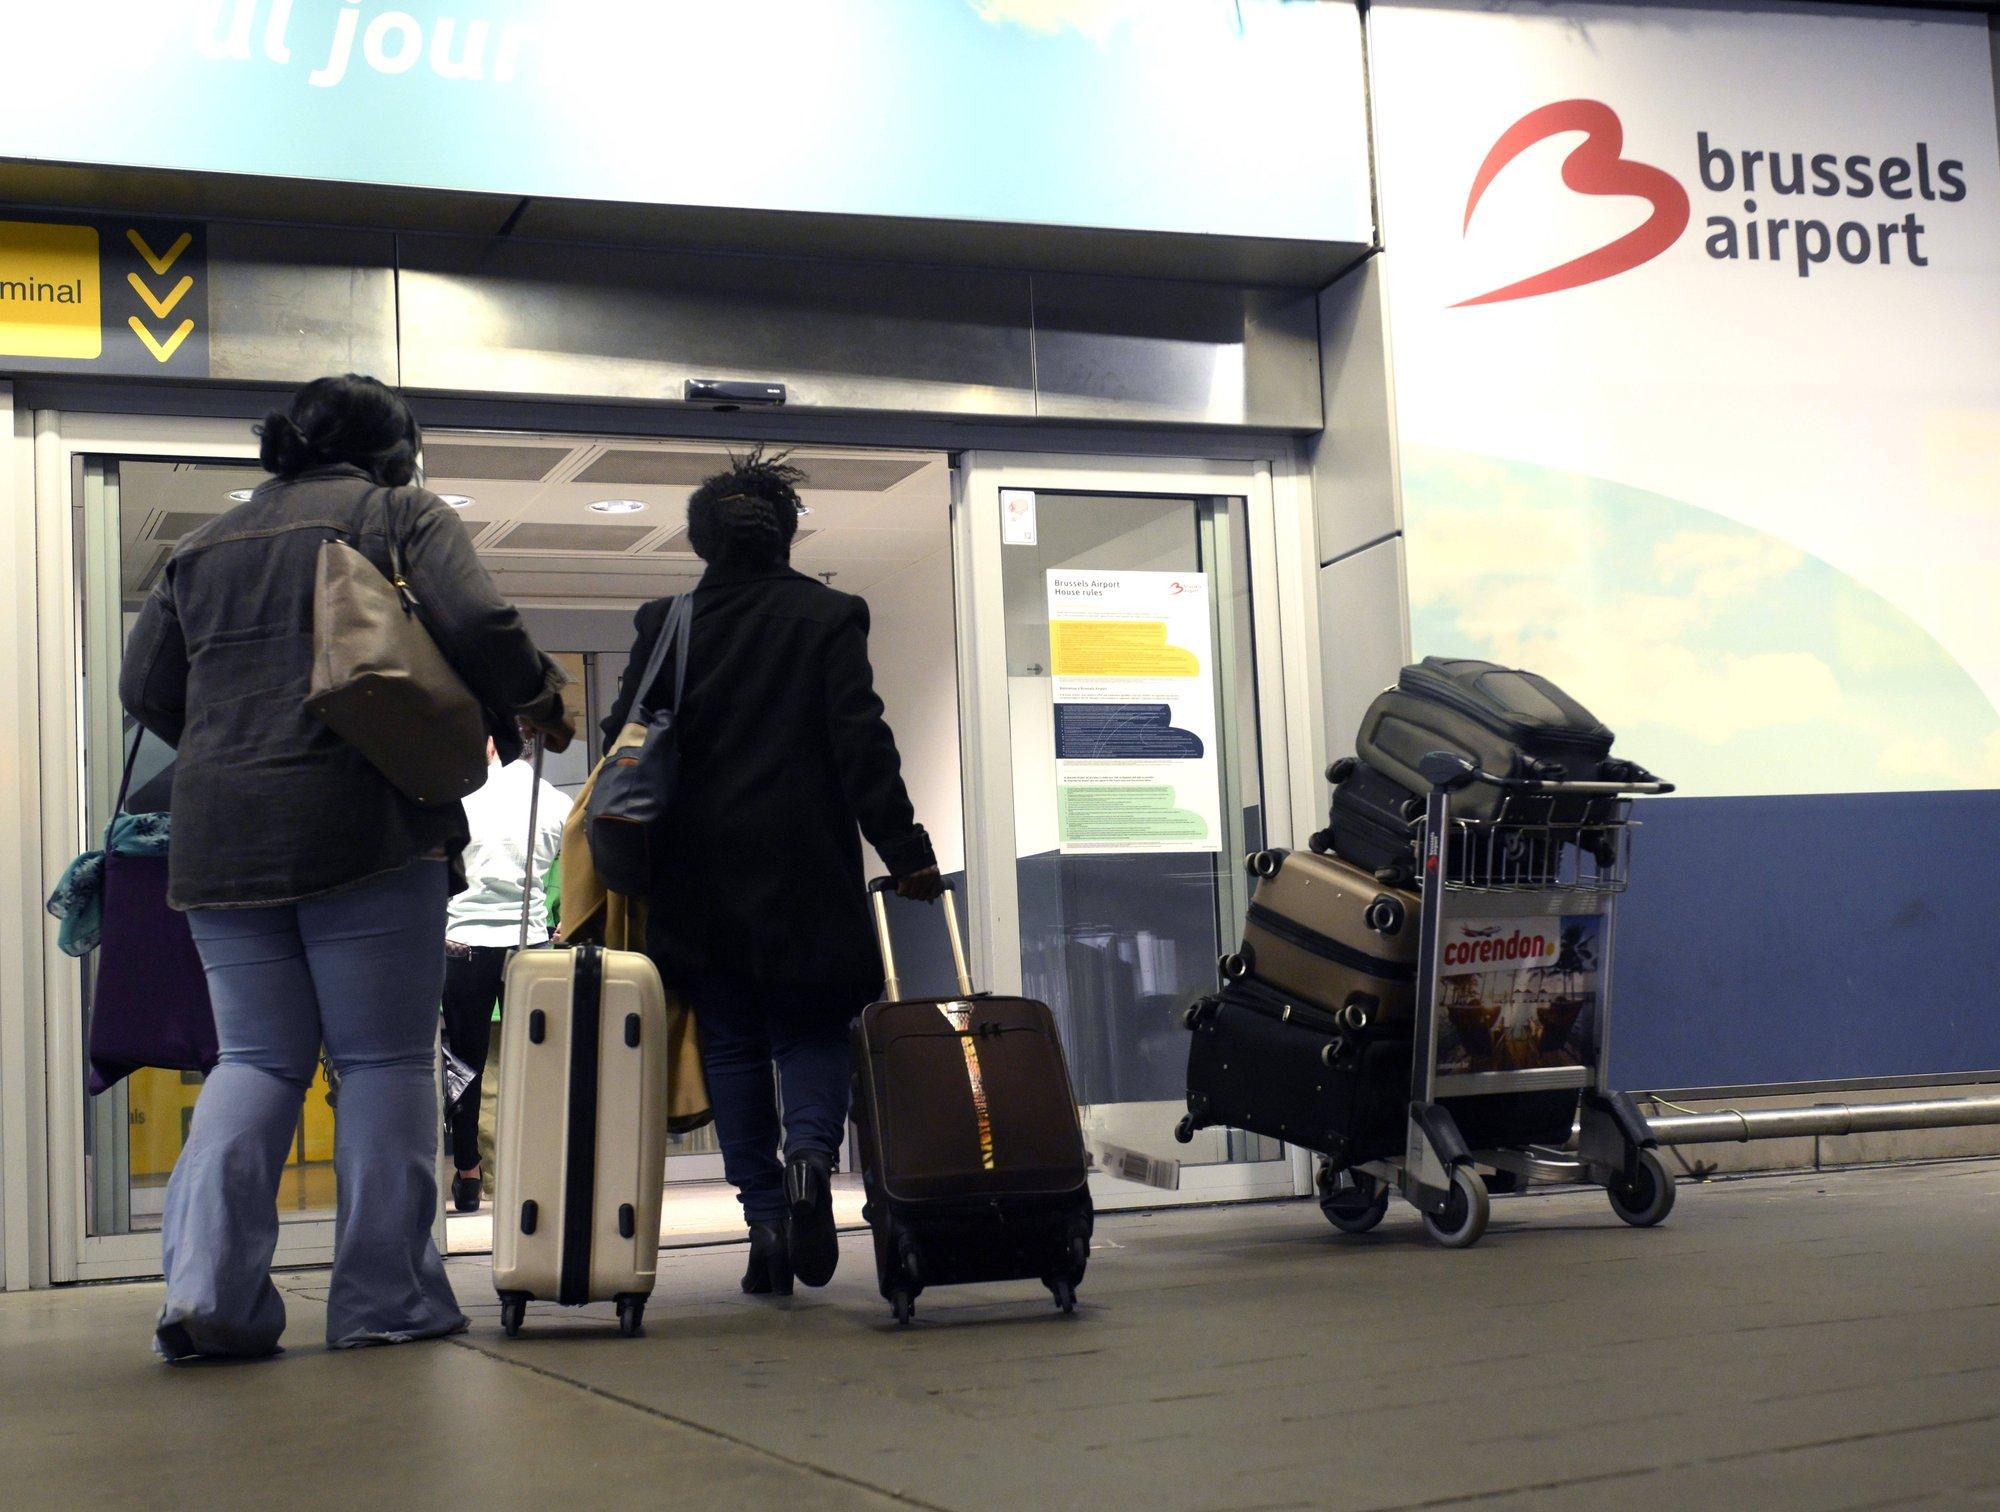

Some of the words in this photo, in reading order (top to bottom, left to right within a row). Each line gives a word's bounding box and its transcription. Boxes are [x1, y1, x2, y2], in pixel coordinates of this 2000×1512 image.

[308, 0, 552, 88] jour
[1697, 131, 1967, 203] brussels
[1705, 199, 1929, 278] airport
[0, 276, 82, 304] minal
[1054, 579, 1089, 588] Brussels
[1091, 579, 1121, 589] Airport
[1055, 588, 1081, 597] House
[1082, 588, 1103, 597] rules
[1444, 929, 1546, 966] corendon
